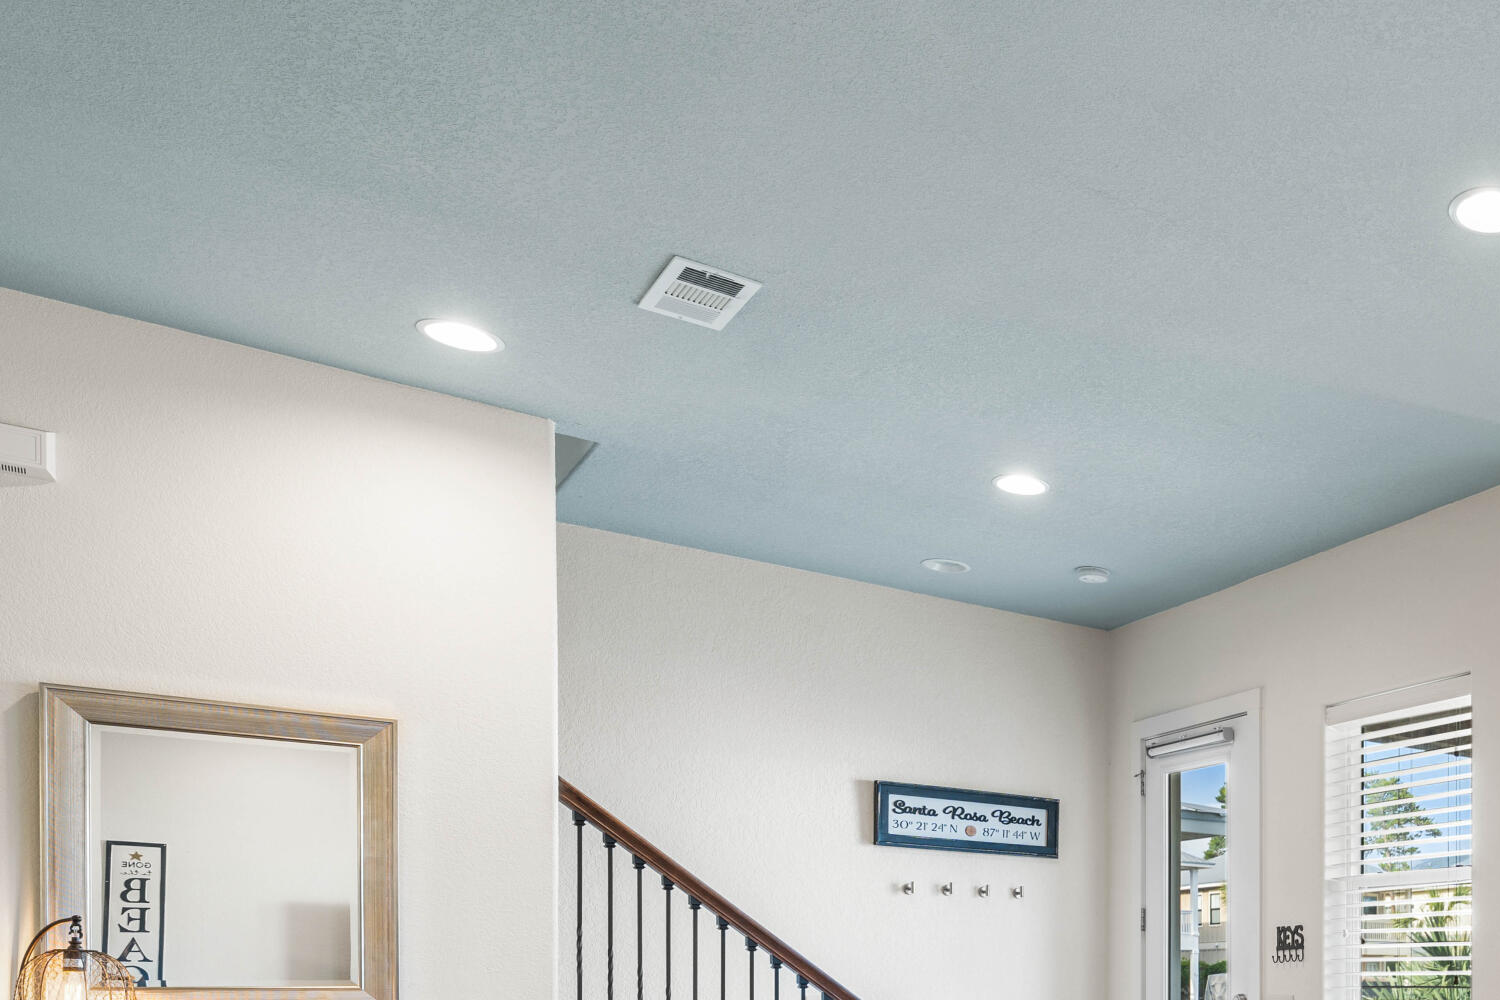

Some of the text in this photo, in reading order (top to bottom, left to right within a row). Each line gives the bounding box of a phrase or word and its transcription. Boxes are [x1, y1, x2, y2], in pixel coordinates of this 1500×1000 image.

[892, 799, 1042, 827] Santa Rosa Beach
[949, 824, 958, 833] N
[1029, 831, 1041, 841] W
[1276, 924, 1305, 949] KEYS
